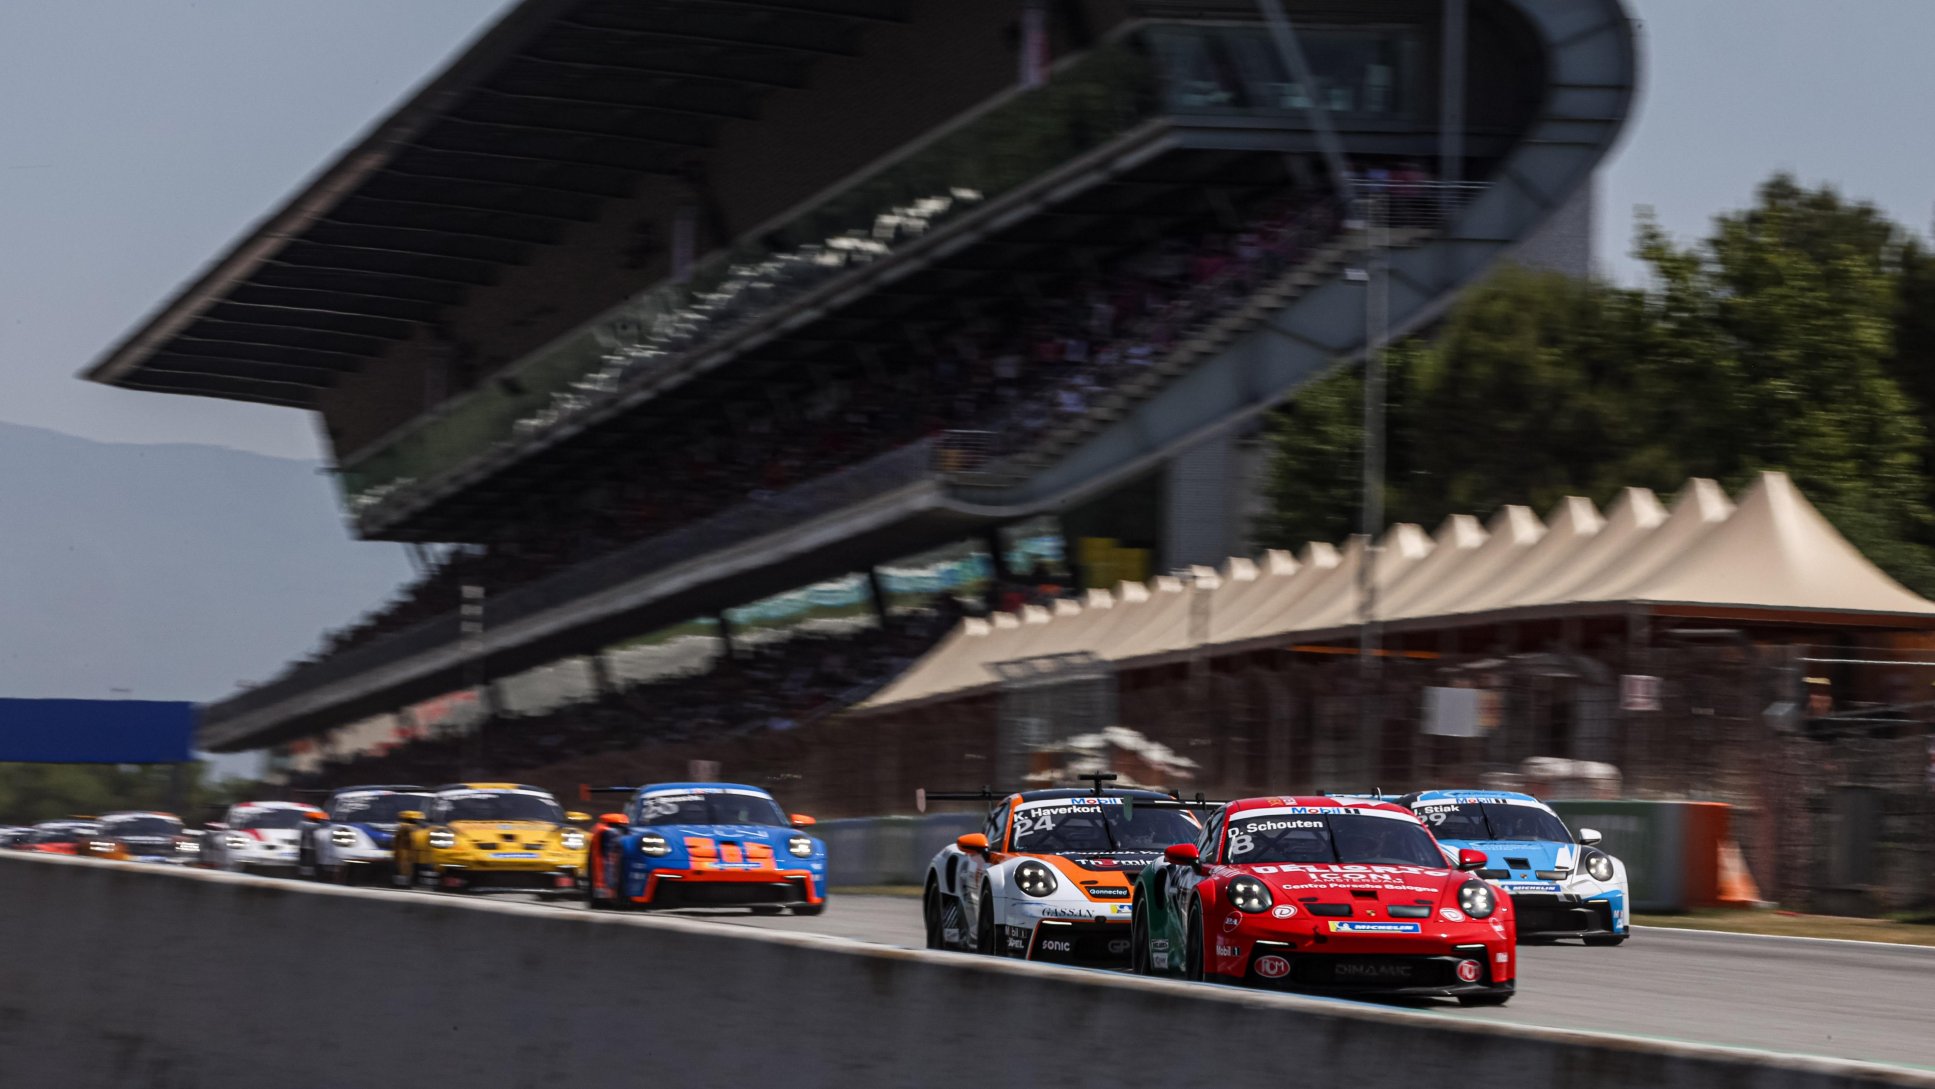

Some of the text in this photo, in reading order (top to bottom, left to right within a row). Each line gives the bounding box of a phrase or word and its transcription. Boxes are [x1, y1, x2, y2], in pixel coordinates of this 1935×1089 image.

[1071, 797, 1117, 805] Mobil
[1014, 805, 1103, 823] K. Haverkort
[1291, 807, 1341, 815] Mobil
[1424, 805, 1460, 814] Stiak
[1013, 815, 1056, 838] 24
[1228, 820, 1324, 838] D. Schouten
[1384, 884, 1439, 893] Bologna
[1042, 908, 1095, 918] GASSAN
